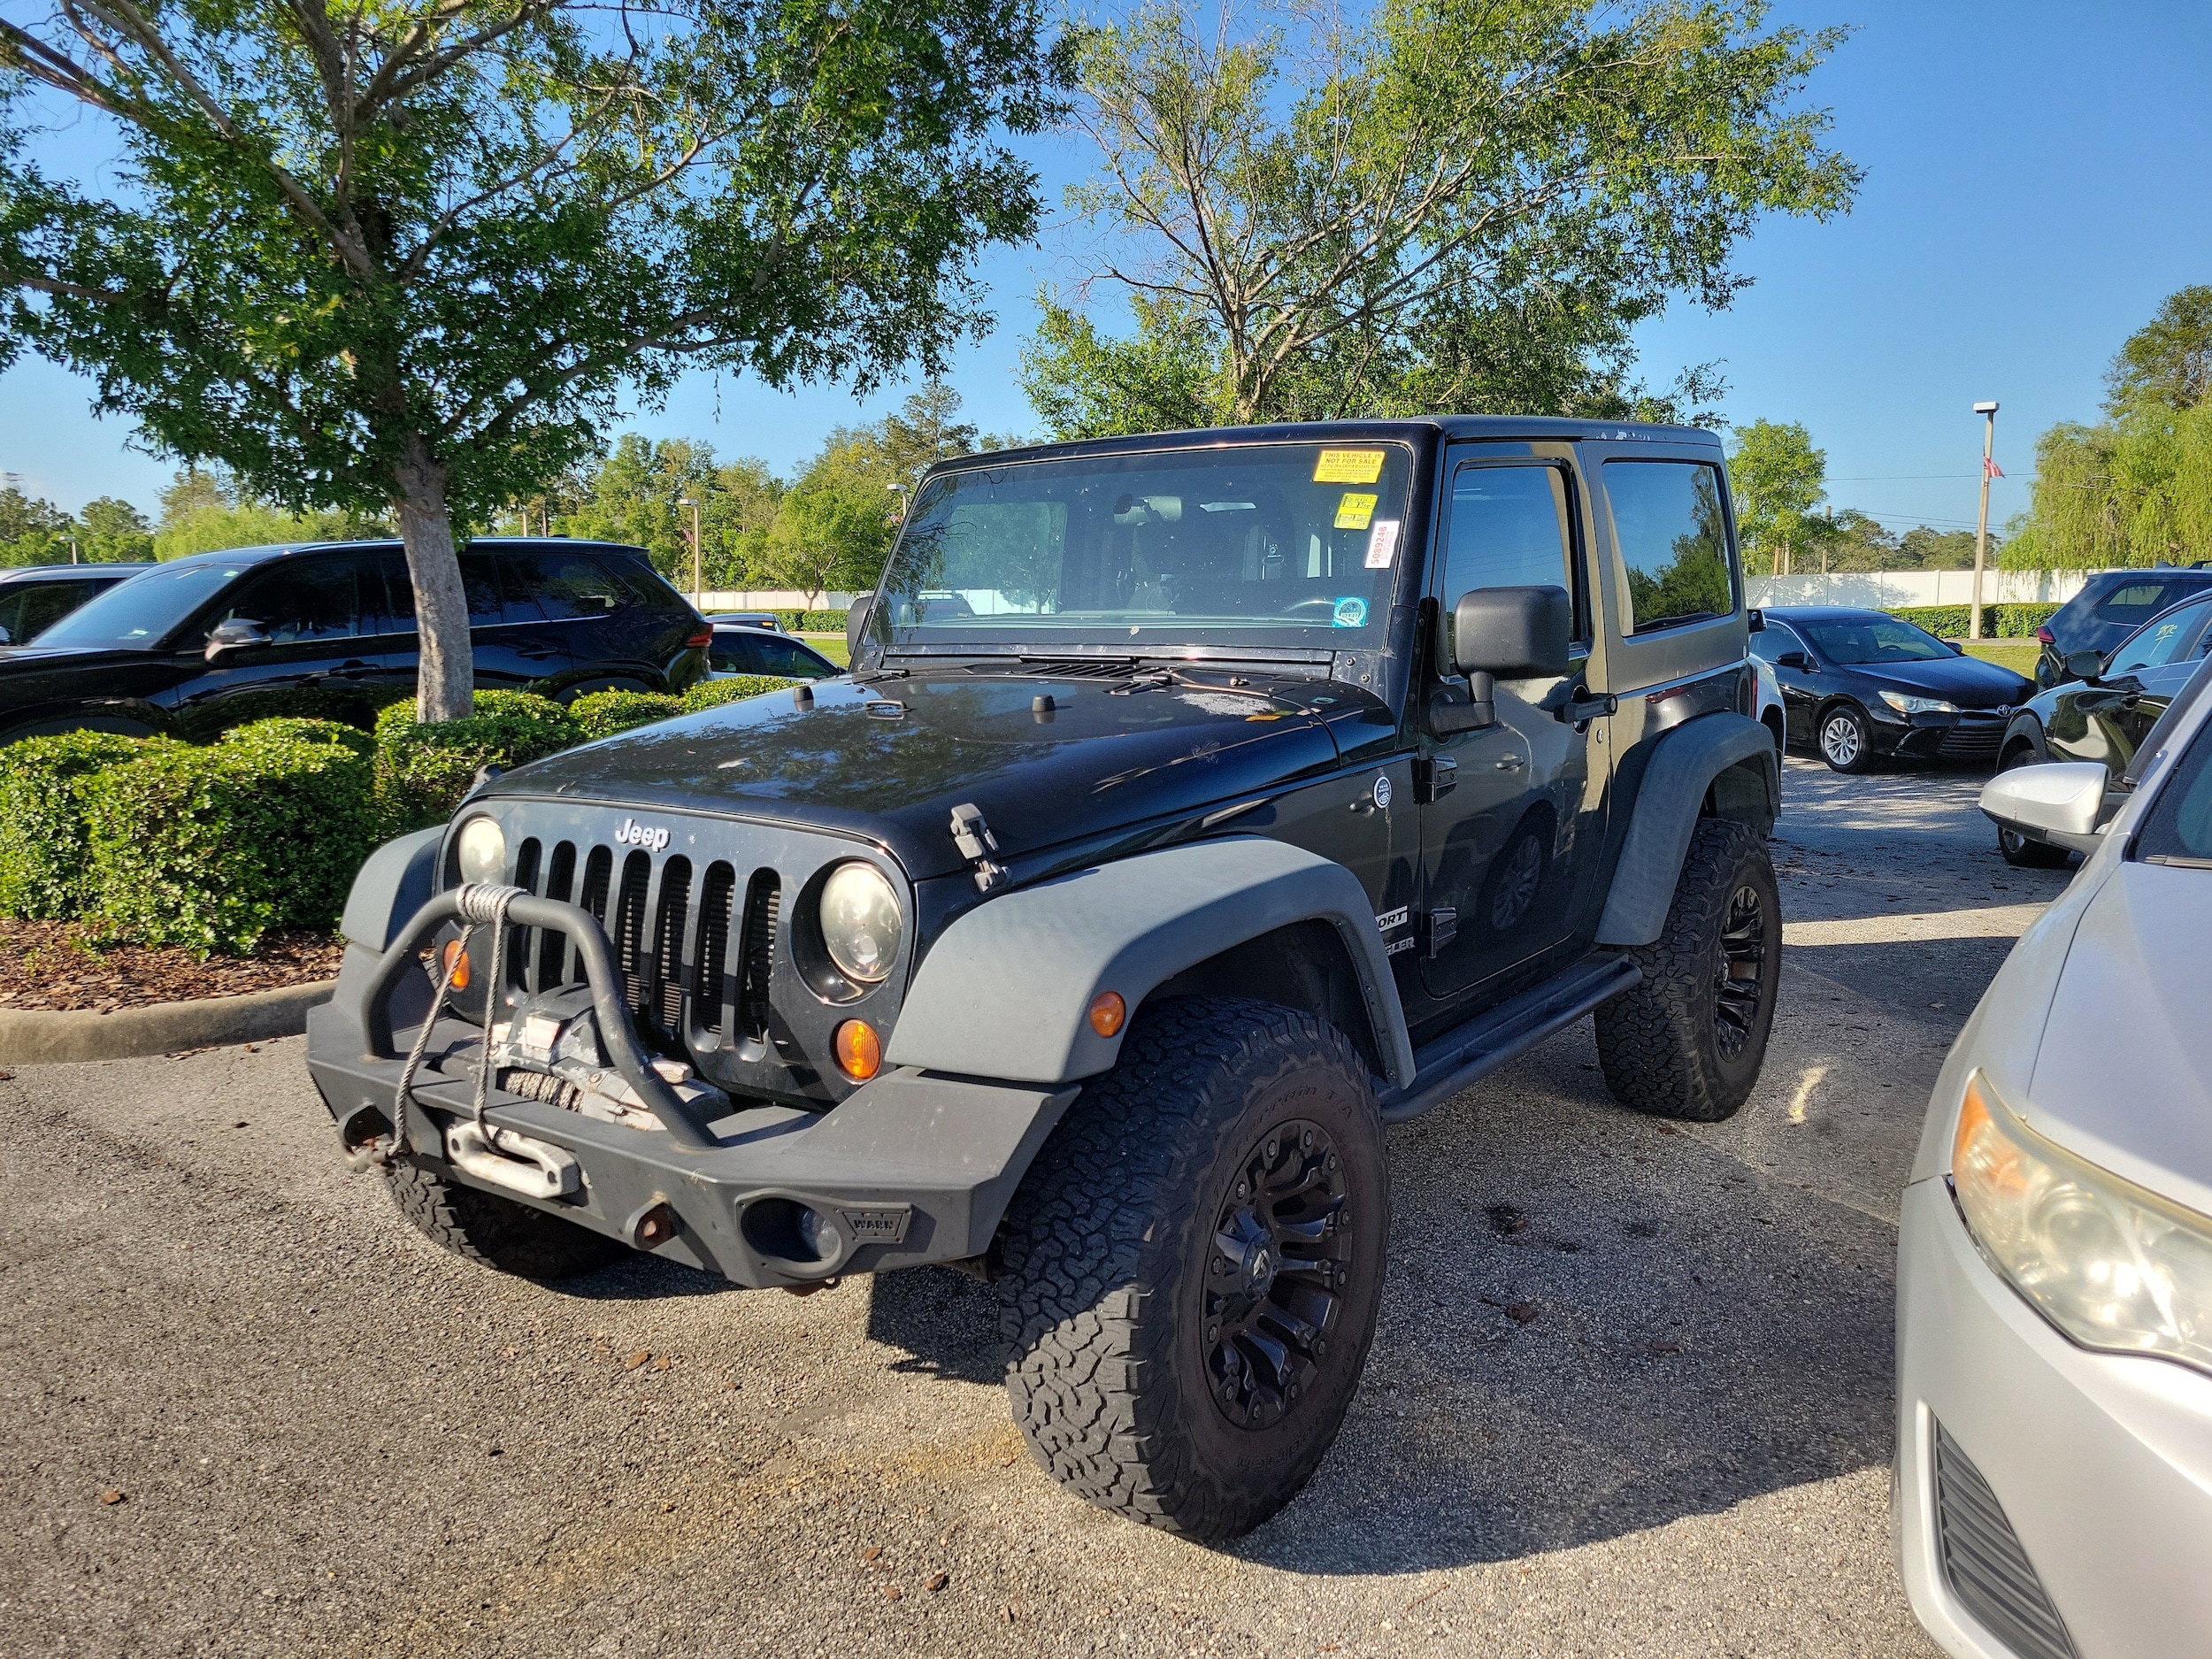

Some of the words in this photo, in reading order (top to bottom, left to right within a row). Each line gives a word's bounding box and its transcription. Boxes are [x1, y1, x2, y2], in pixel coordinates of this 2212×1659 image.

[1371, 526, 1387, 565] 5089248
[615, 818, 670, 853] Jeep
[1378, 910, 1408, 928] ORT
[1324, 1087, 1354, 1123] T/A
[853, 1219, 895, 1230] WARN
